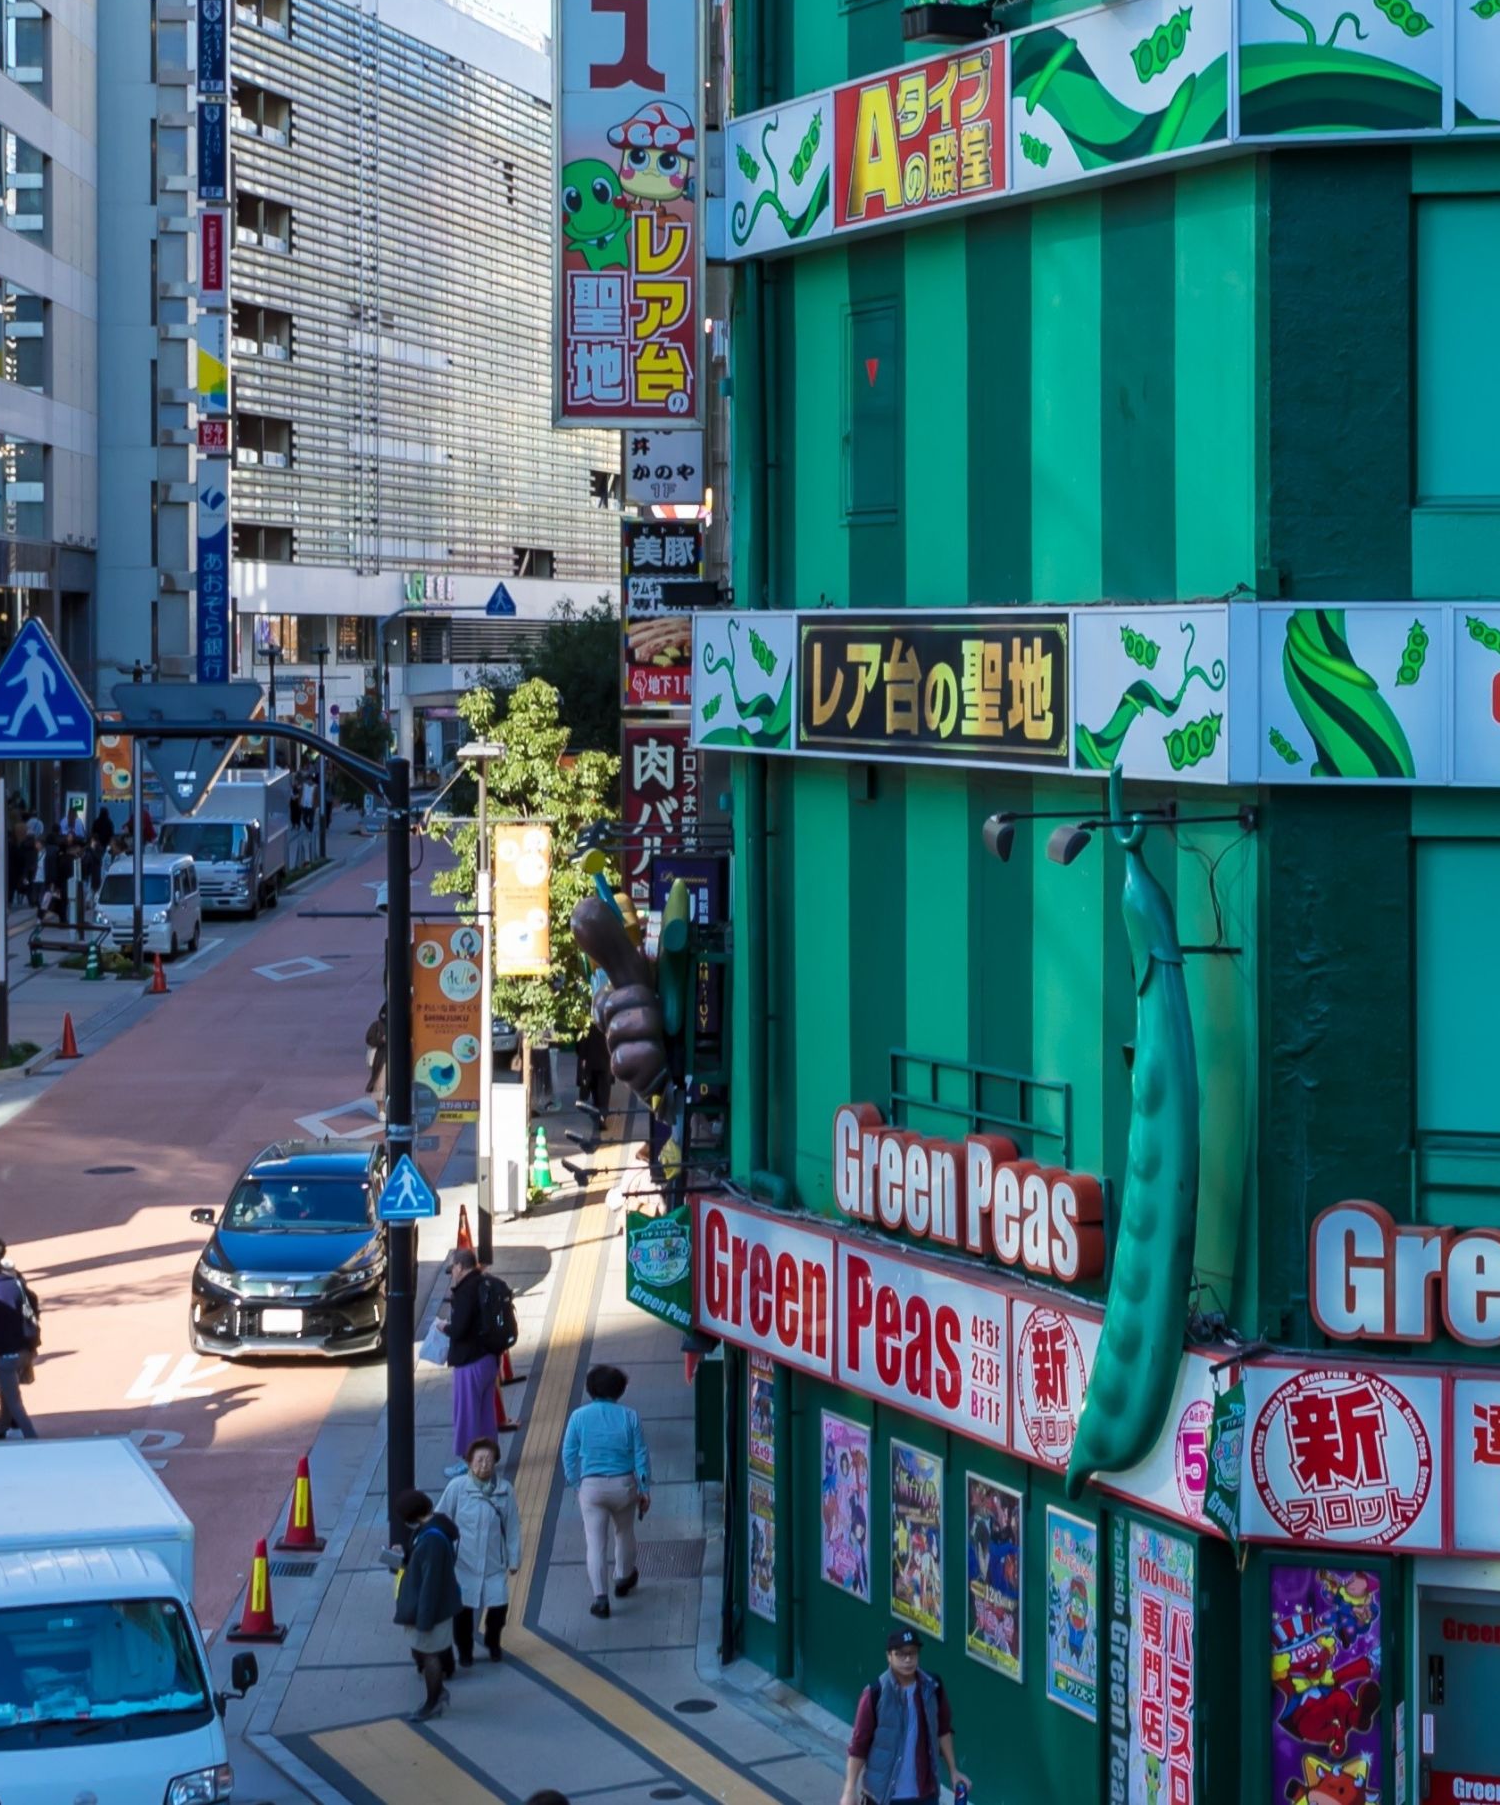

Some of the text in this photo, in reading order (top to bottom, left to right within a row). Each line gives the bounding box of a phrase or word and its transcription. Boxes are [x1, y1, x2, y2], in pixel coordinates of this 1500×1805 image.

[570, 278, 624, 403] 聖地
[633, 218, 690, 413] レア台の
[203, 434, 224, 445] ビル
[632, 437, 650, 456] 丼
[632, 463, 695, 481] かのや
[651, 483, 676, 498] 1F
[633, 536, 694, 567] 美豚
[203, 550, 224, 679] あおぞら銀行
[810, 636, 1054, 741] レア台の聖地
[423, 1014, 470, 1023] SHINJUKU
[836, 1107, 1079, 1278] Green Peas
[630, 1286, 692, 1328] Green Peas
[704, 1208, 828, 1360] Green
[846, 1253, 962, 1412] Peas
[1031, 1326, 1073, 1412] 新
[1288, 1386, 1387, 1491] 新
[1287, 1488, 1418, 1534] スロット
[1110, 1513, 1127, 1714] Pachislo Green
[1140, 1593, 1165, 1755] 専門店
[1168, 1606, 1193, 1805] パチスロ
